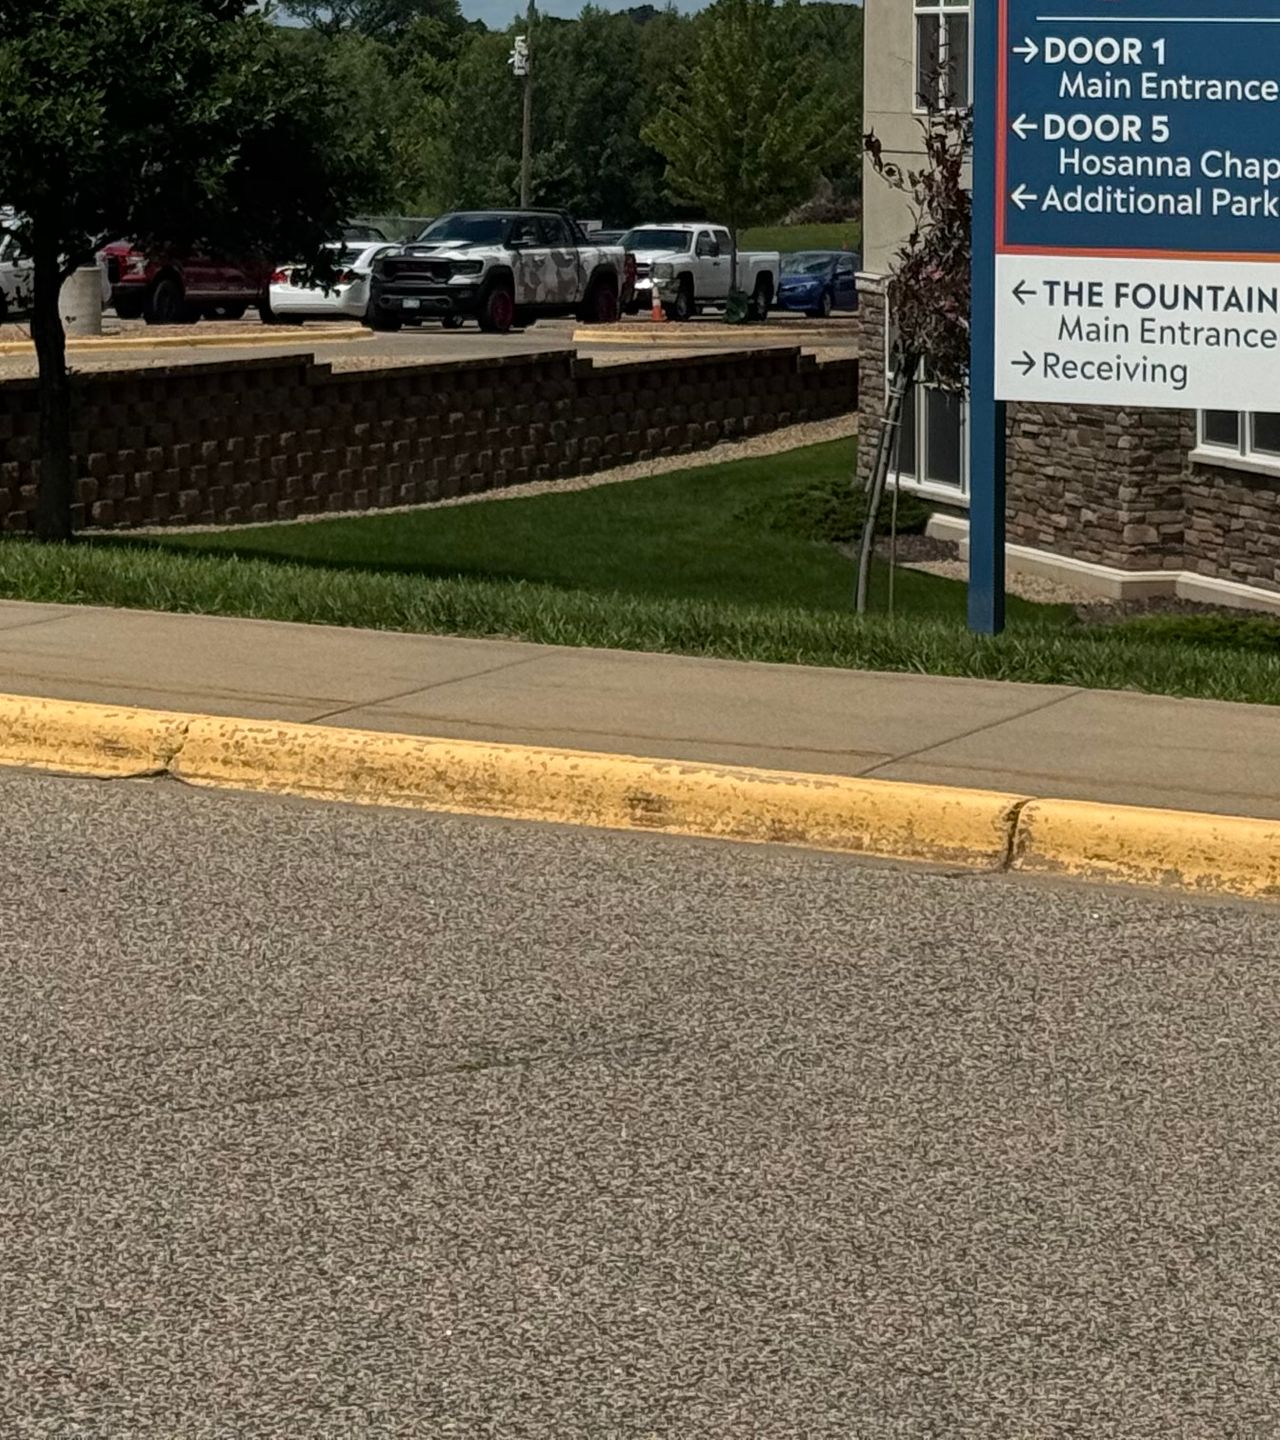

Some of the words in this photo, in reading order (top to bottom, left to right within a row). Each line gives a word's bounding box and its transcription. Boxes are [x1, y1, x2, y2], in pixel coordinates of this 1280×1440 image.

[1044, 36, 1143, 65] DOOR
[1152, 37, 1166, 65] 1
[1059, 70, 1131, 99] Main
[1141, 71, 1279, 101] Entrance
[1044, 113, 1143, 142] DOOR
[1151, 115, 1170, 143] 5
[1059, 147, 1191, 179] Hosanna
[1041, 184, 1202, 215] Additional
[1042, 280, 1104, 308] THE
[1058, 315, 1129, 343] Main
[1140, 317, 1277, 349] Entrance
[1043, 352, 1188, 391] Receiving
